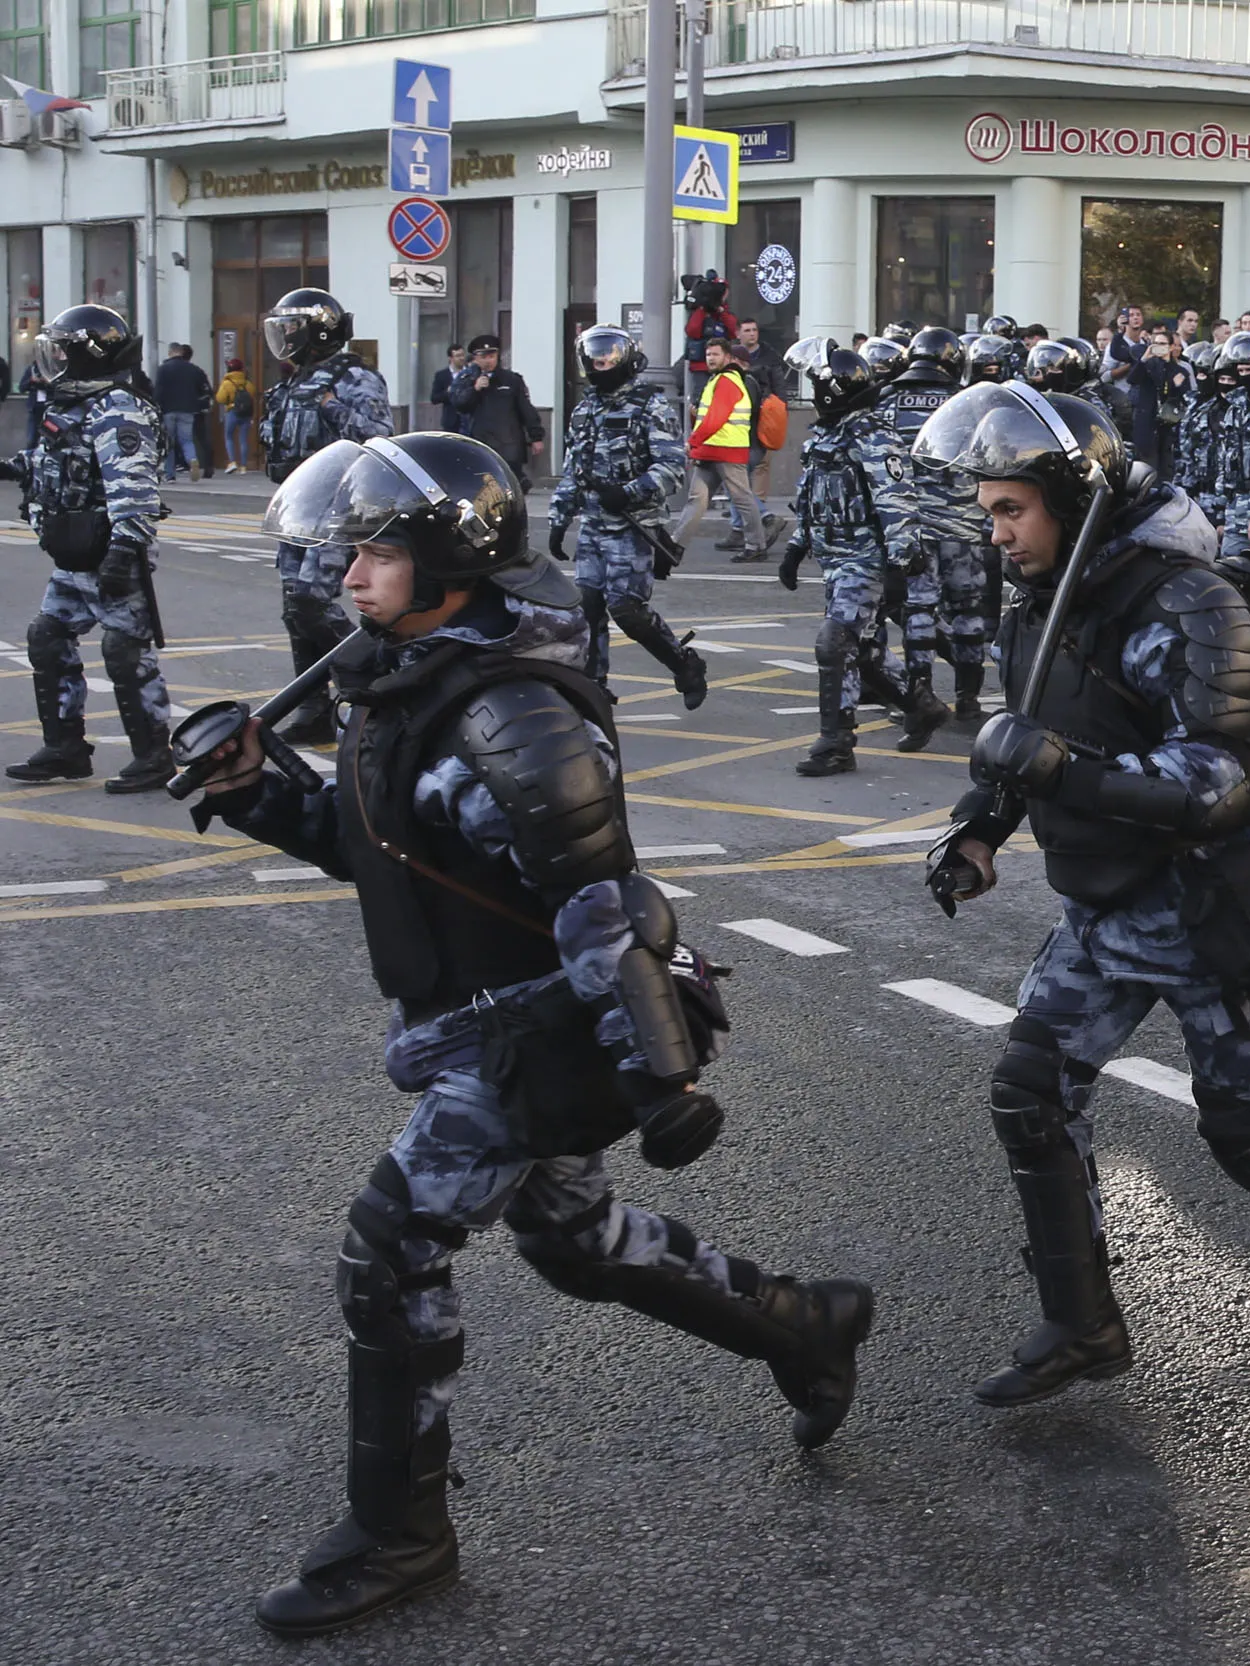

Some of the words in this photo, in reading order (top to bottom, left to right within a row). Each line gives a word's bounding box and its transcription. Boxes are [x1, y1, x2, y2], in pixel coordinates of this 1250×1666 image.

[201, 163, 319, 198] Российский
[324, 160, 384, 190] Союз
[451, 148, 516, 188] дёжи
[537, 144, 612, 177] кофейня
[768, 266, 782, 282] 24
